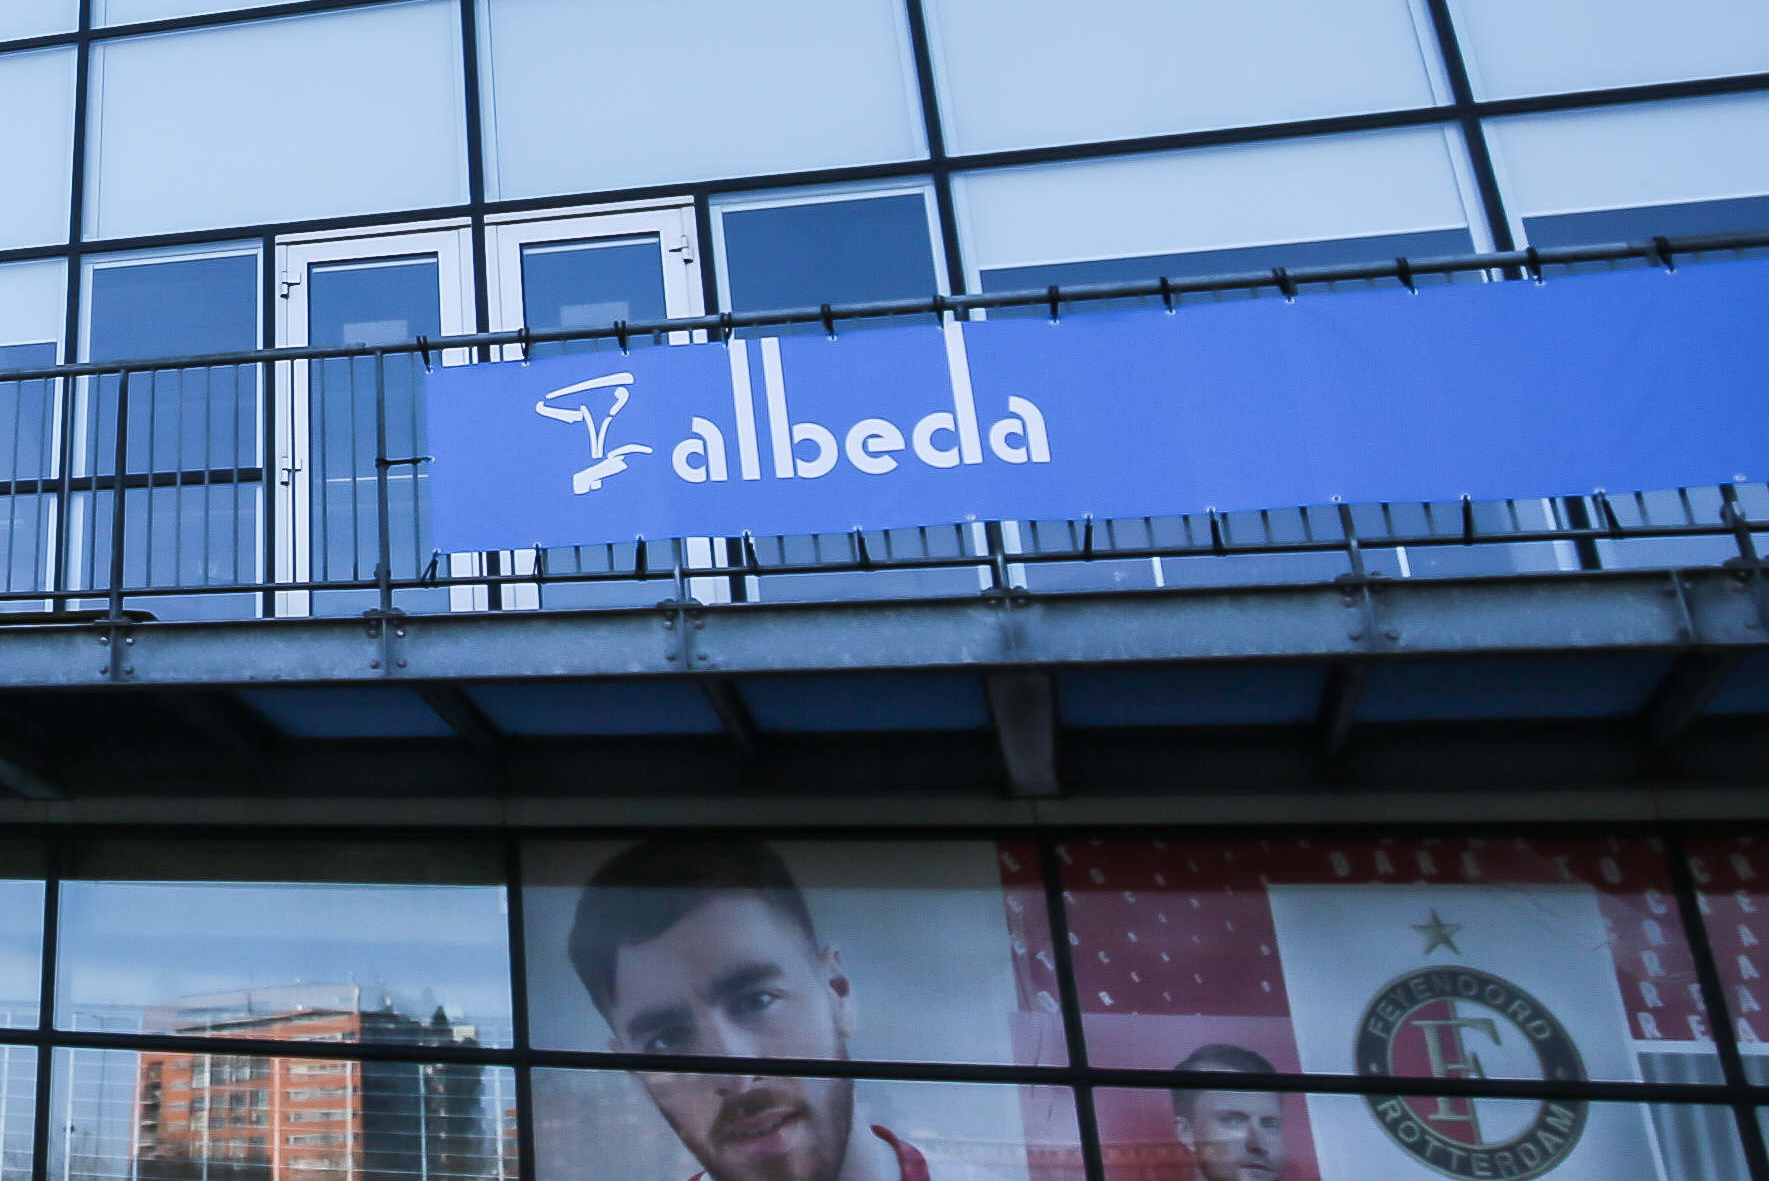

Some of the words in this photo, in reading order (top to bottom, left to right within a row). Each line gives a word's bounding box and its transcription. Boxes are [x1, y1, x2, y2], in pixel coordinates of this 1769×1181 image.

[671, 321, 1051, 483] albeda
[1368, 973, 1553, 1041] FEYENOORD
[1376, 1100, 1578, 1179] ROTTERDAM
